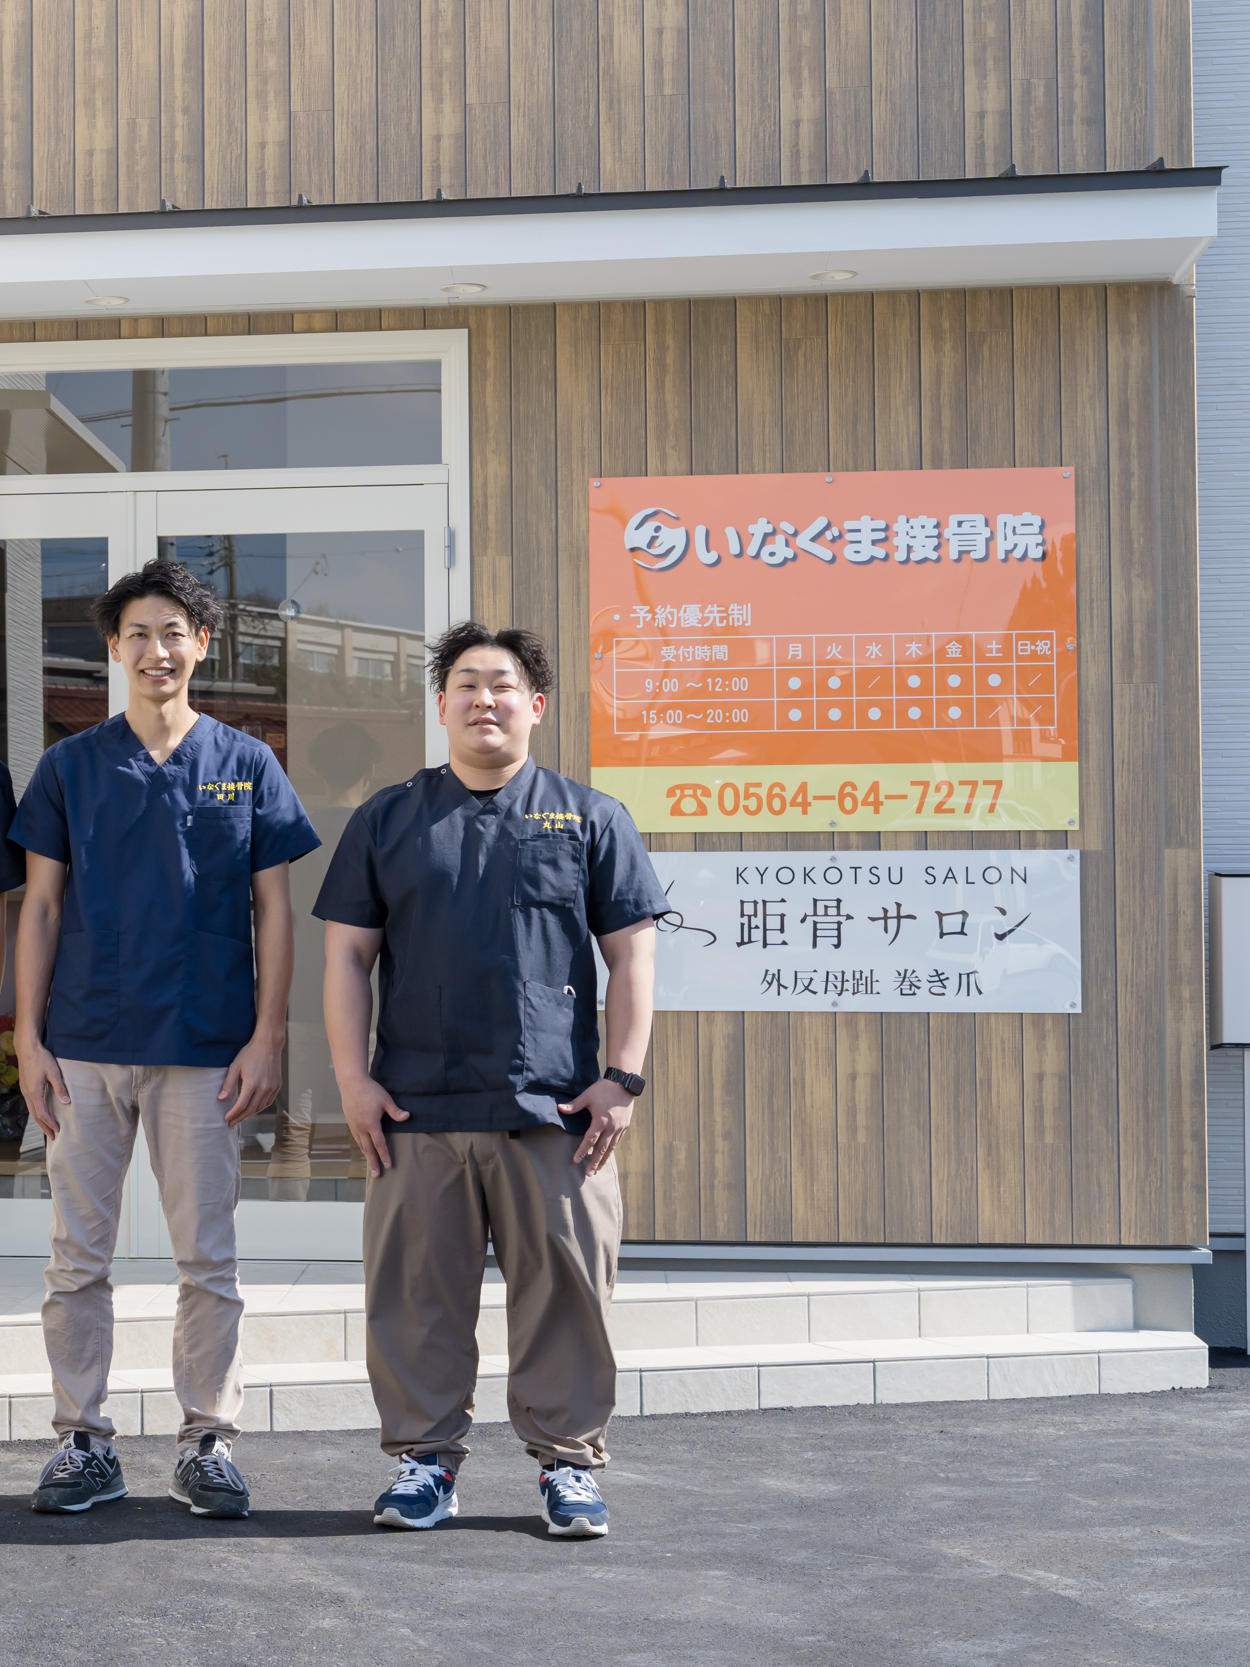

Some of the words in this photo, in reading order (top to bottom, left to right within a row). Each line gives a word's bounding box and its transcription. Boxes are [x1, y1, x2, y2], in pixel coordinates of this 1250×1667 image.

[694, 512, 1046, 564] いなぐま接骨院
[629, 603, 752, 629] 予約優先制
[660, 644, 729, 663] 受付時間
[787, 643, 803, 660] 月
[826, 642, 843, 660] 火
[865, 641, 883, 659] 水
[905, 640, 923, 658] 木
[945, 640, 963, 658] 金
[985, 640, 1003, 657] 土
[716, 779, 1004, 817] 0564-64-7277
[735, 866, 904, 885] KYOKOTSU
[924, 865, 1028, 885] SALON
[735, 897, 1032, 950] 距骨サロン
[760, 968, 881, 997] 外反母趾
[892, 968, 984, 997] 巻き爪
